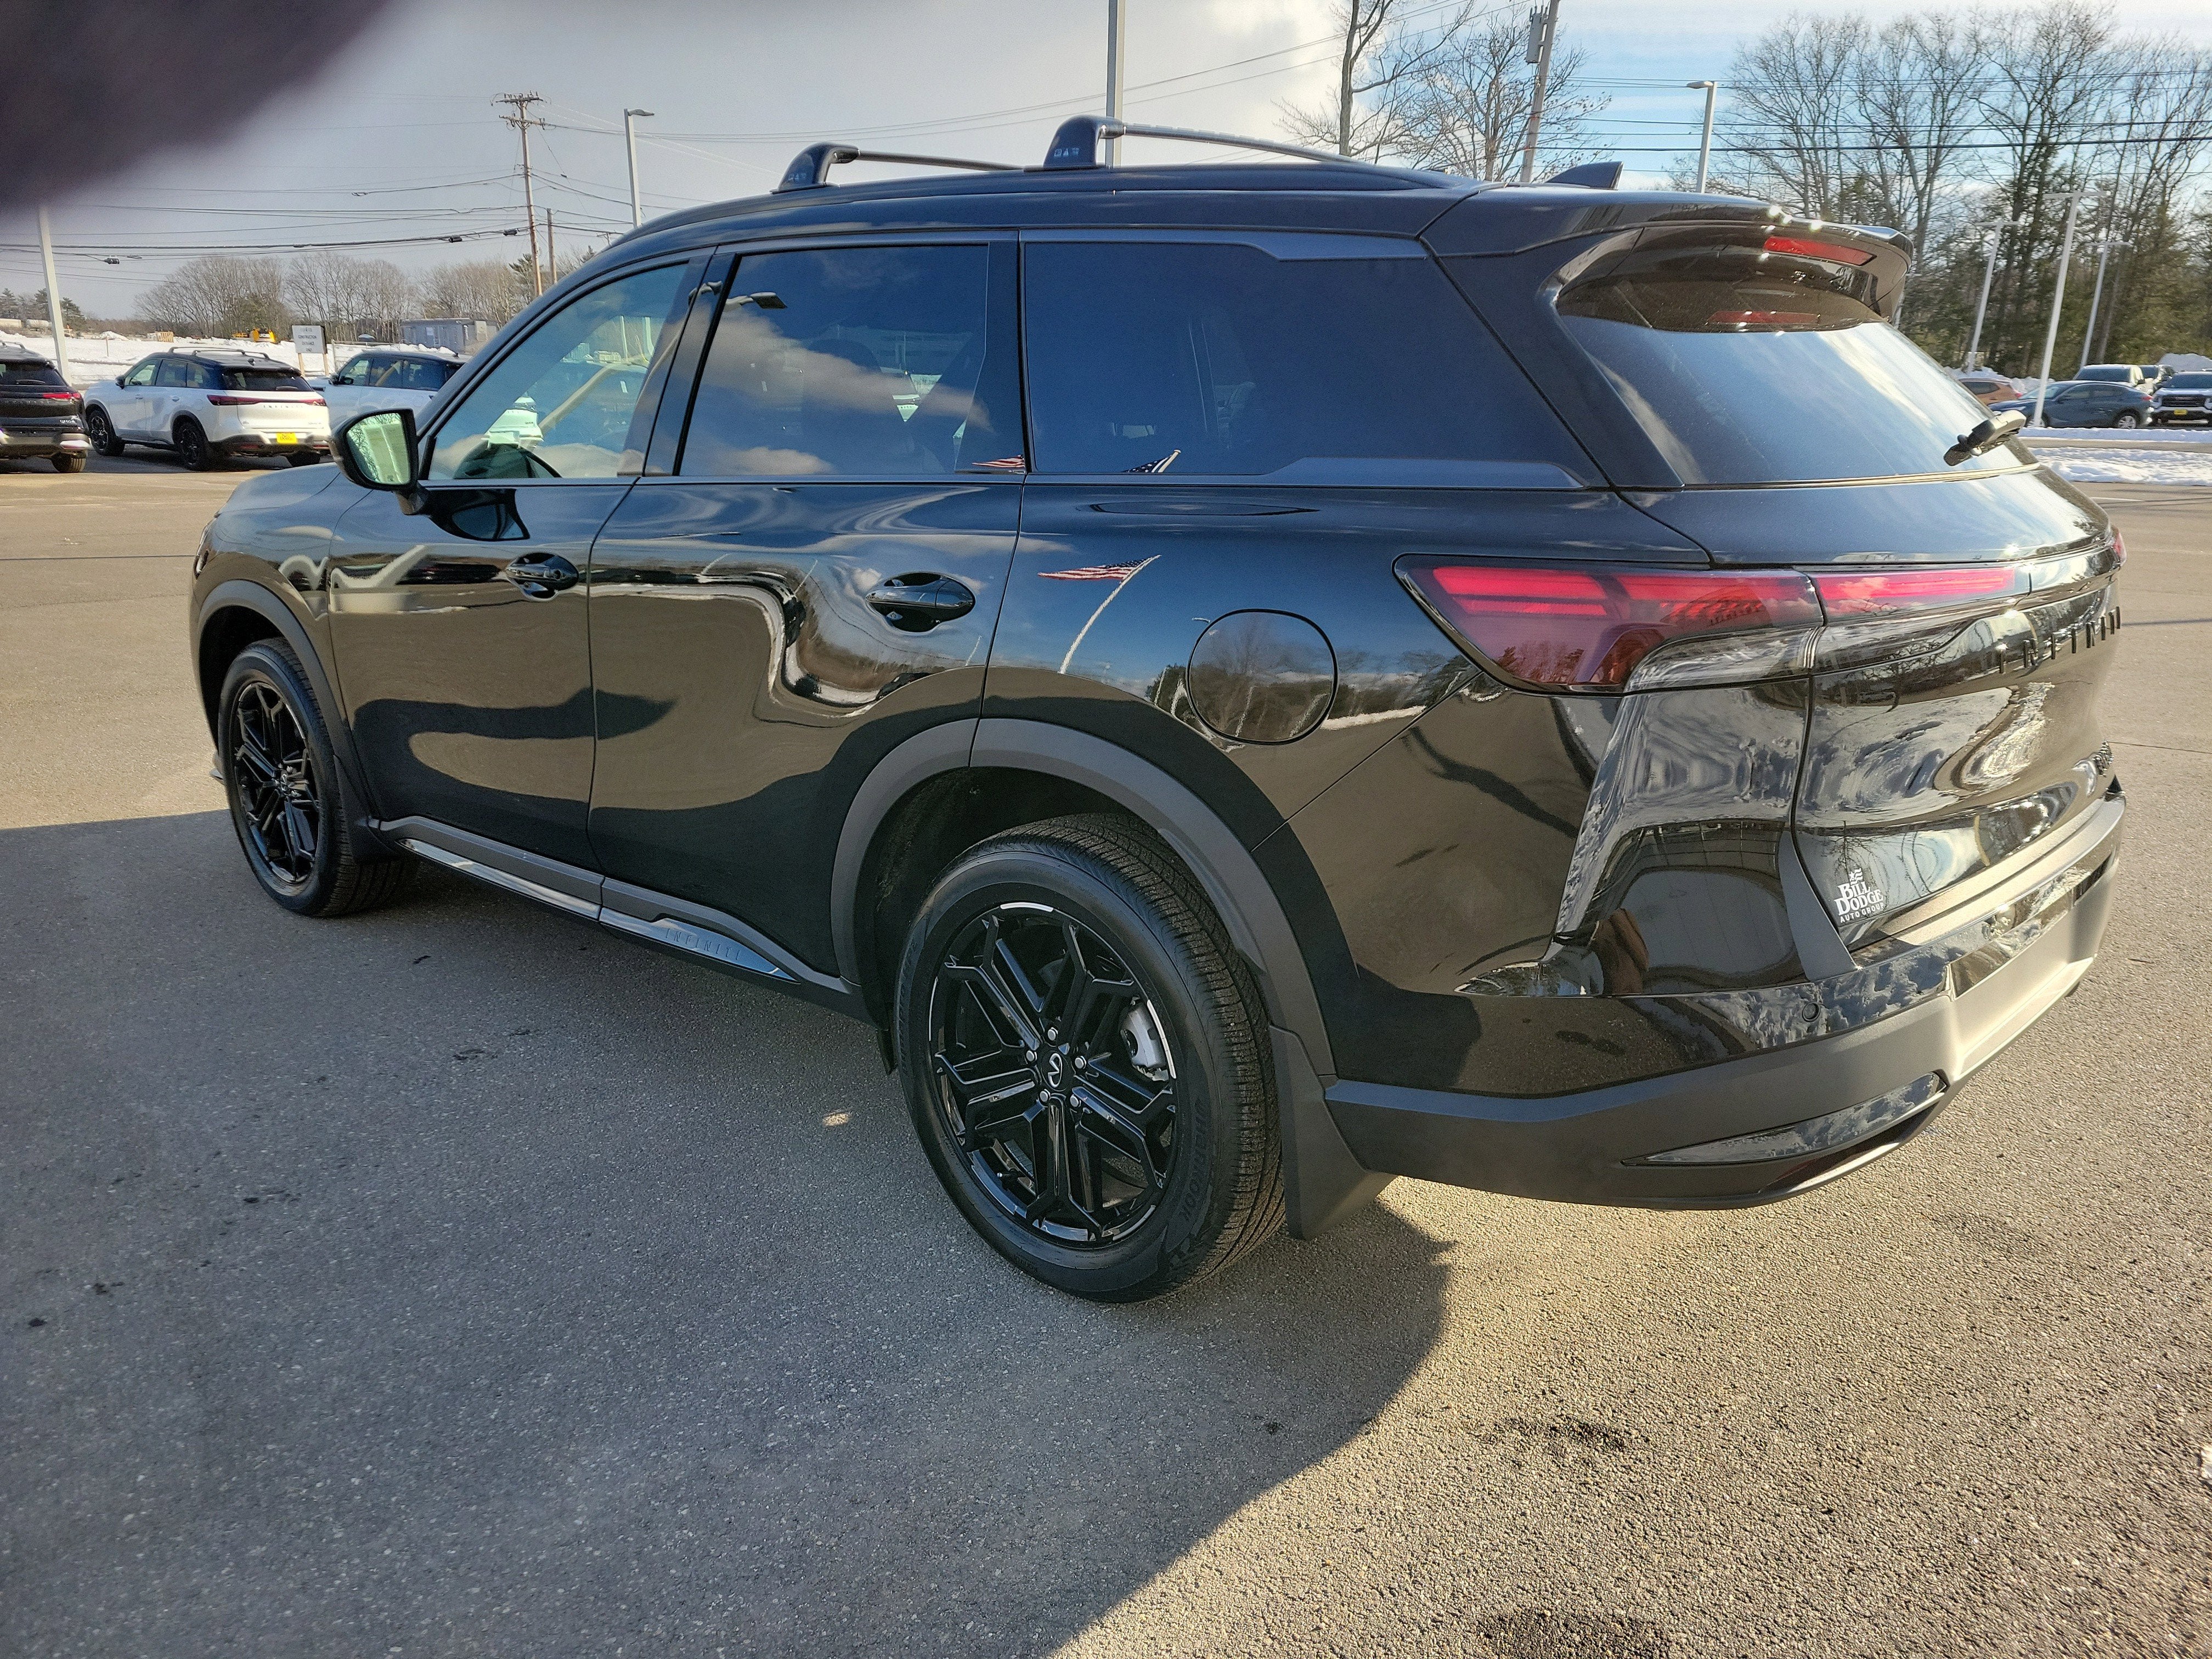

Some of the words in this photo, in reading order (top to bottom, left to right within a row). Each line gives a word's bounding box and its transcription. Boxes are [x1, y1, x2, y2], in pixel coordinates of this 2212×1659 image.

[1834, 889, 1883, 916] DODGE
[1838, 881, 1871, 900] BILL
[1840, 911, 1860, 923] AUTO
[1861, 902, 1884, 916] GROUP
[665, 928, 741, 961] INFINITI
